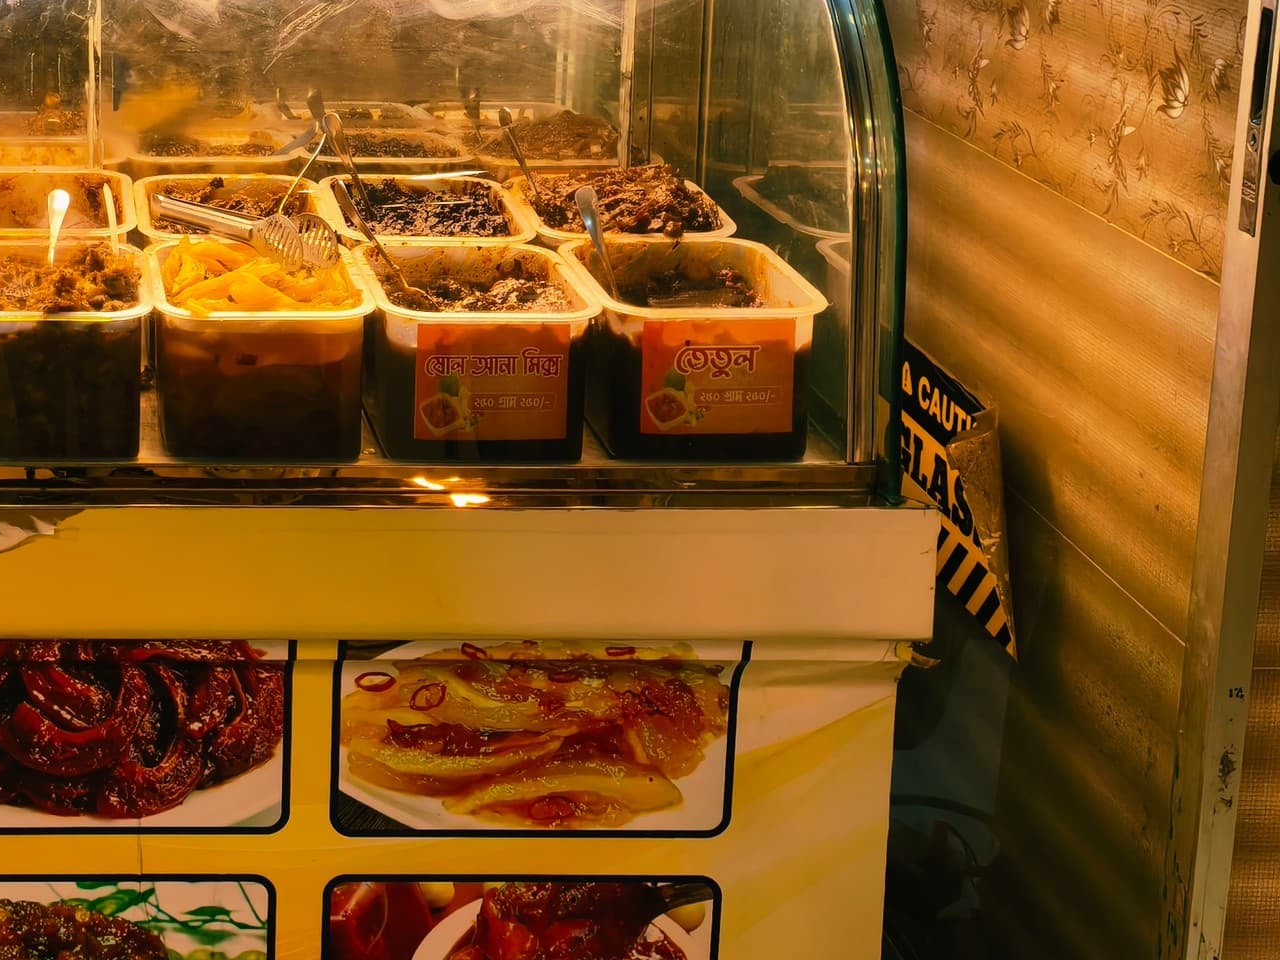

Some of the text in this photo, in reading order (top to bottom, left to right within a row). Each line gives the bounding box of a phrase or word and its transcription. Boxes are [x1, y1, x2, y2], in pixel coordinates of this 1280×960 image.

[470, 354, 520, 377] আনা
[520, 347, 563, 378] মিক্স
[918, 376, 977, 432] CAUTI
